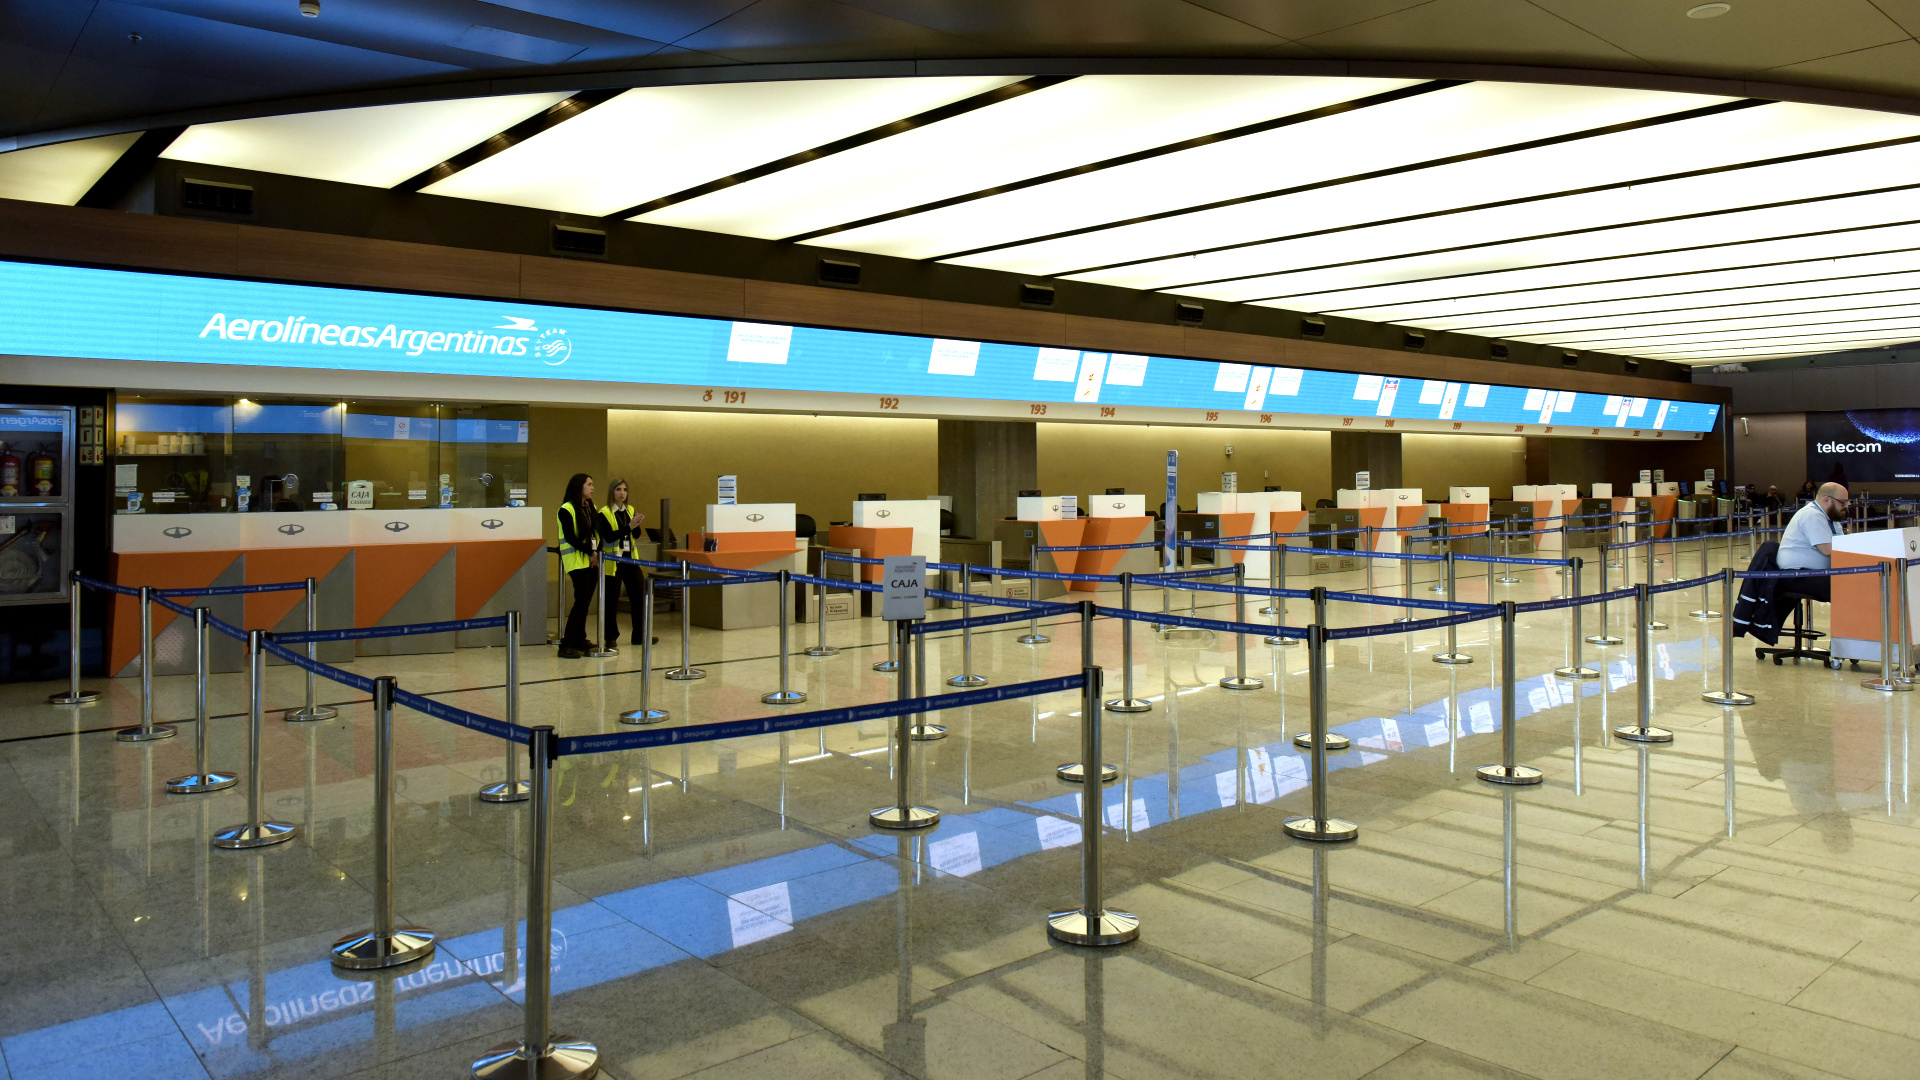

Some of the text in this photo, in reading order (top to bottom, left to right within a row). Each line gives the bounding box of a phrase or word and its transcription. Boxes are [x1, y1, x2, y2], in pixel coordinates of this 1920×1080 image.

[534, 328, 566, 358] SKYTEAM
[724, 391, 746, 404] 191
[879, 397, 899, 410] 192
[1030, 404, 1047, 415] 193
[1100, 407, 1116, 417] 194
[1205, 412, 1219, 422] 195
[1260, 414, 1272, 423] 196
[1342, 418, 1353, 426] 197
[1384, 420, 1395, 428] 198
[1453, 422, 1462, 430] 199
[1816, 441, 1882, 453] telecom
[350, 491, 369, 499] CAJA
[891, 579, 918, 588] CAJA
[683, 729, 716, 739] despegar
[583, 738, 619, 749] despegar
